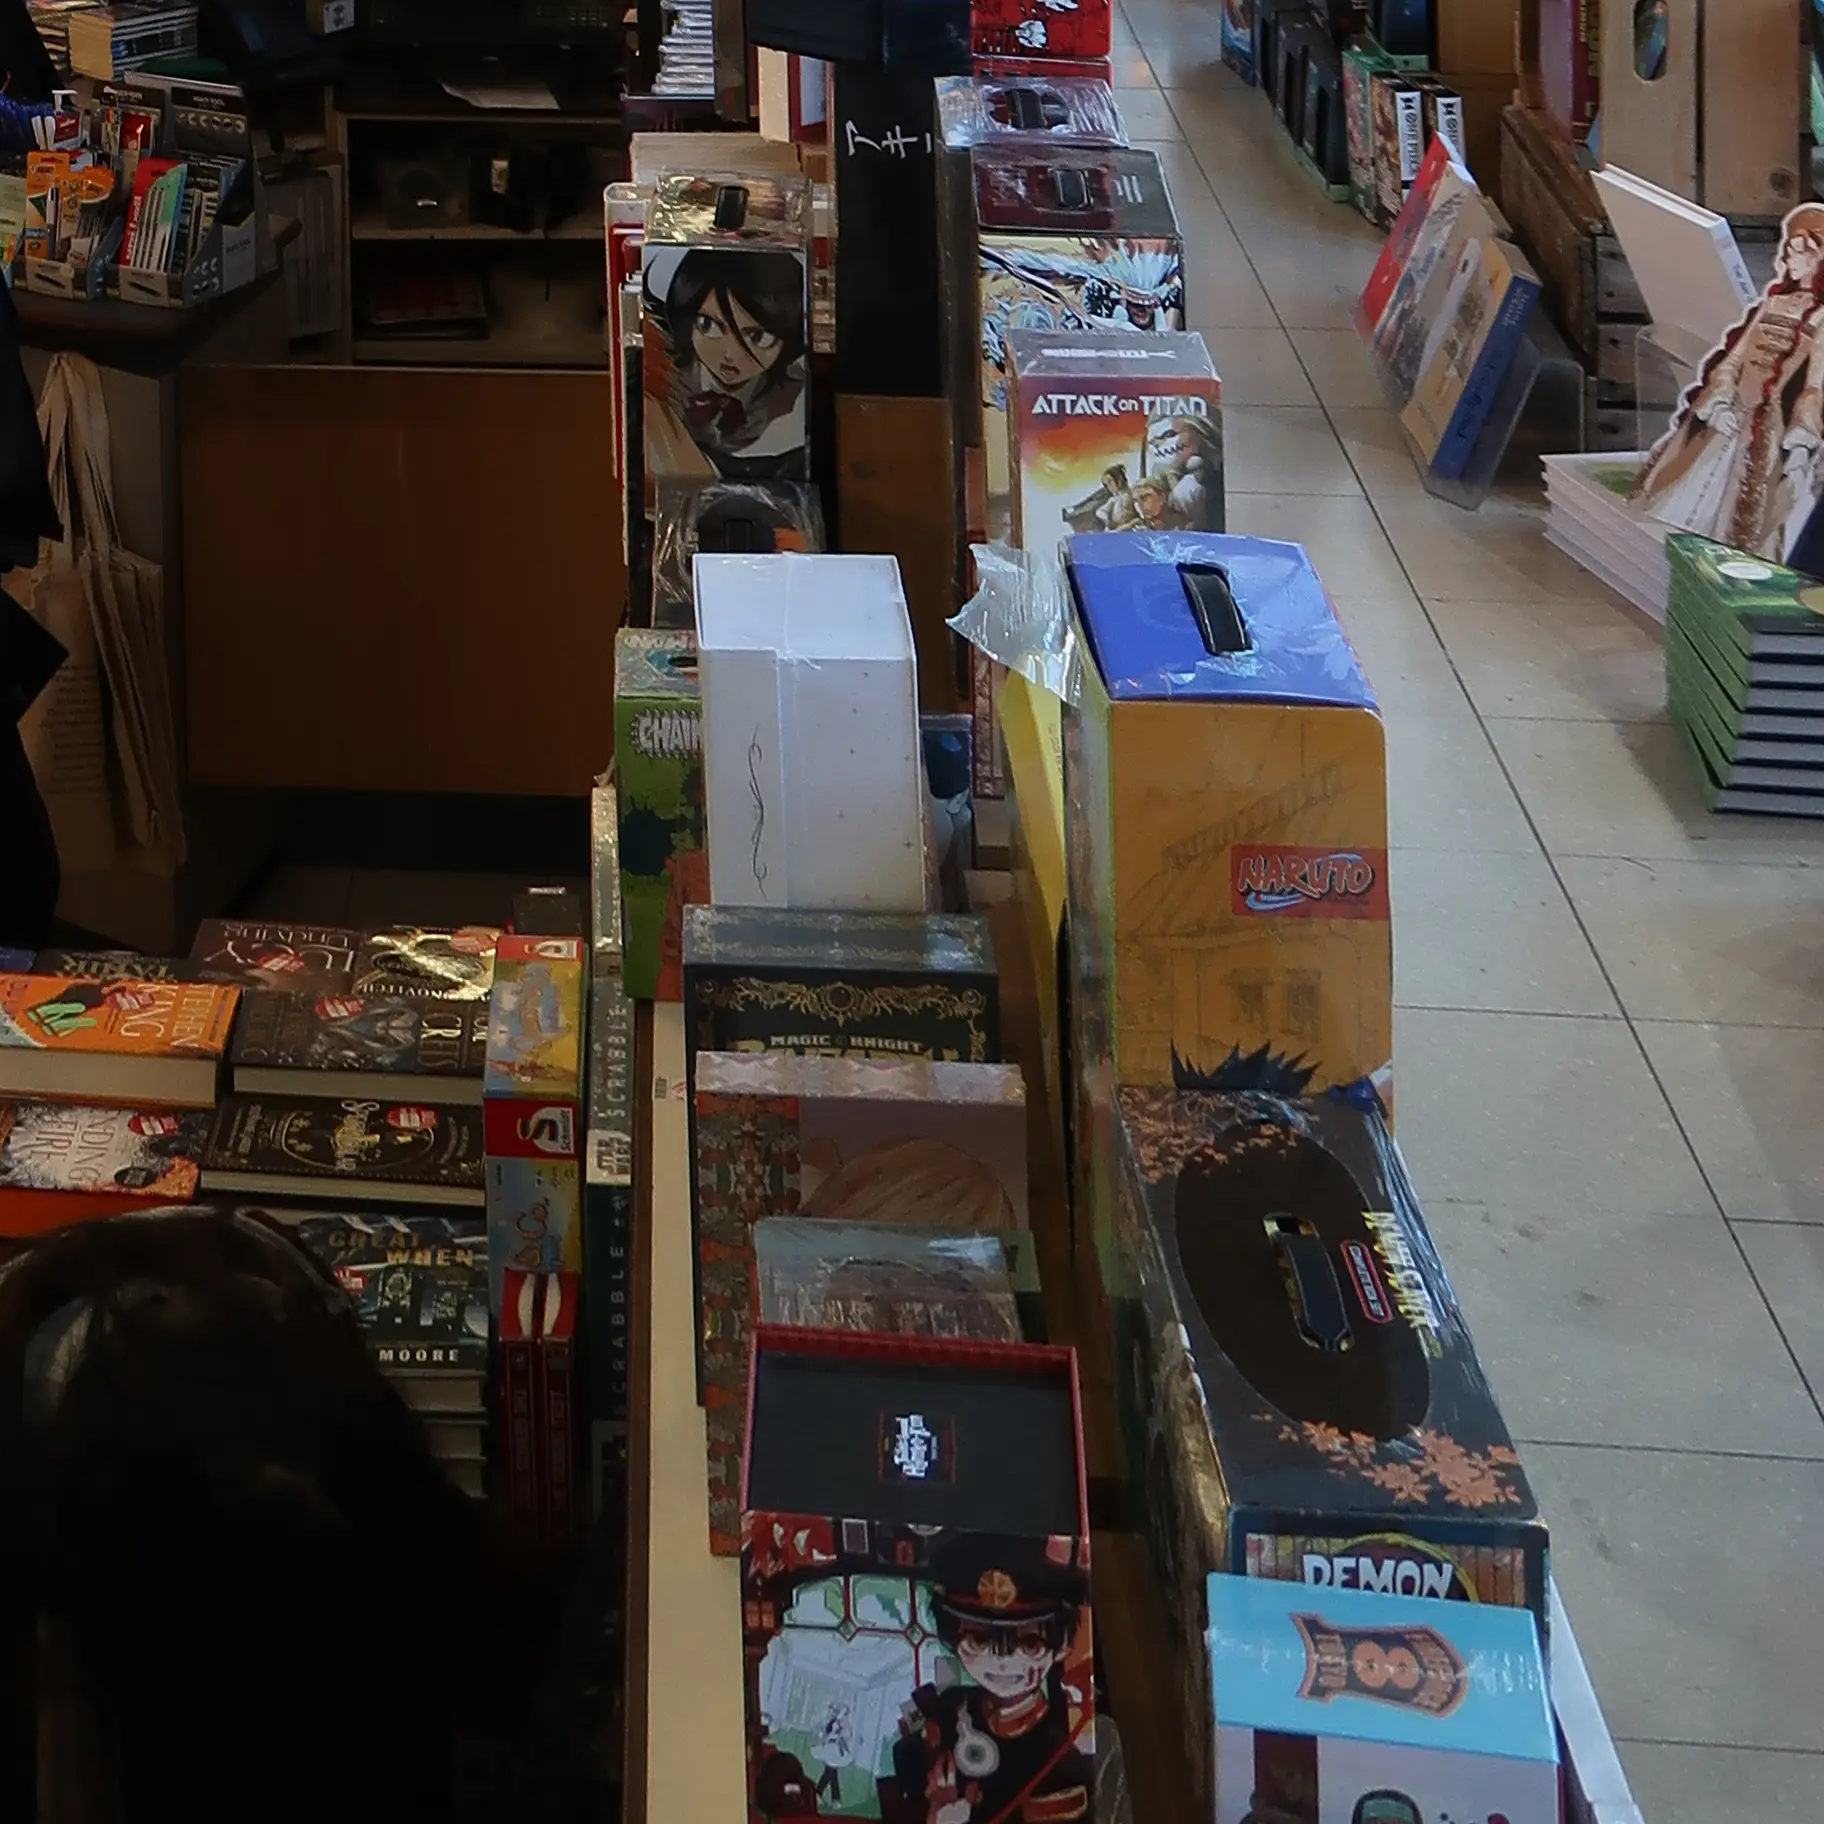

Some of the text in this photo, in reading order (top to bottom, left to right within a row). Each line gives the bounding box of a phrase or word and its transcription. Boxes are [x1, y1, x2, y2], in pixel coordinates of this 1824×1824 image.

[1031, 393, 1209, 418] ATTACK on TITAN
[1236, 853, 1376, 898] NARUTO
[202, 940, 355, 974] LUCY
[120, 981, 180, 1039] KING
[769, 1035, 831, 1049] MAGIC
[849, 1035, 925, 1052] KNIGHT
[606, 1005, 629, 1120] SCRABBLE
[327, 1229, 423, 1248] GREAT
[385, 1247, 474, 1268] WHEN
[610, 1244, 626, 1415] SCRABBLE
[378, 1348, 461, 1364] MOORE
[1301, 1553, 1455, 1599] DEMON
